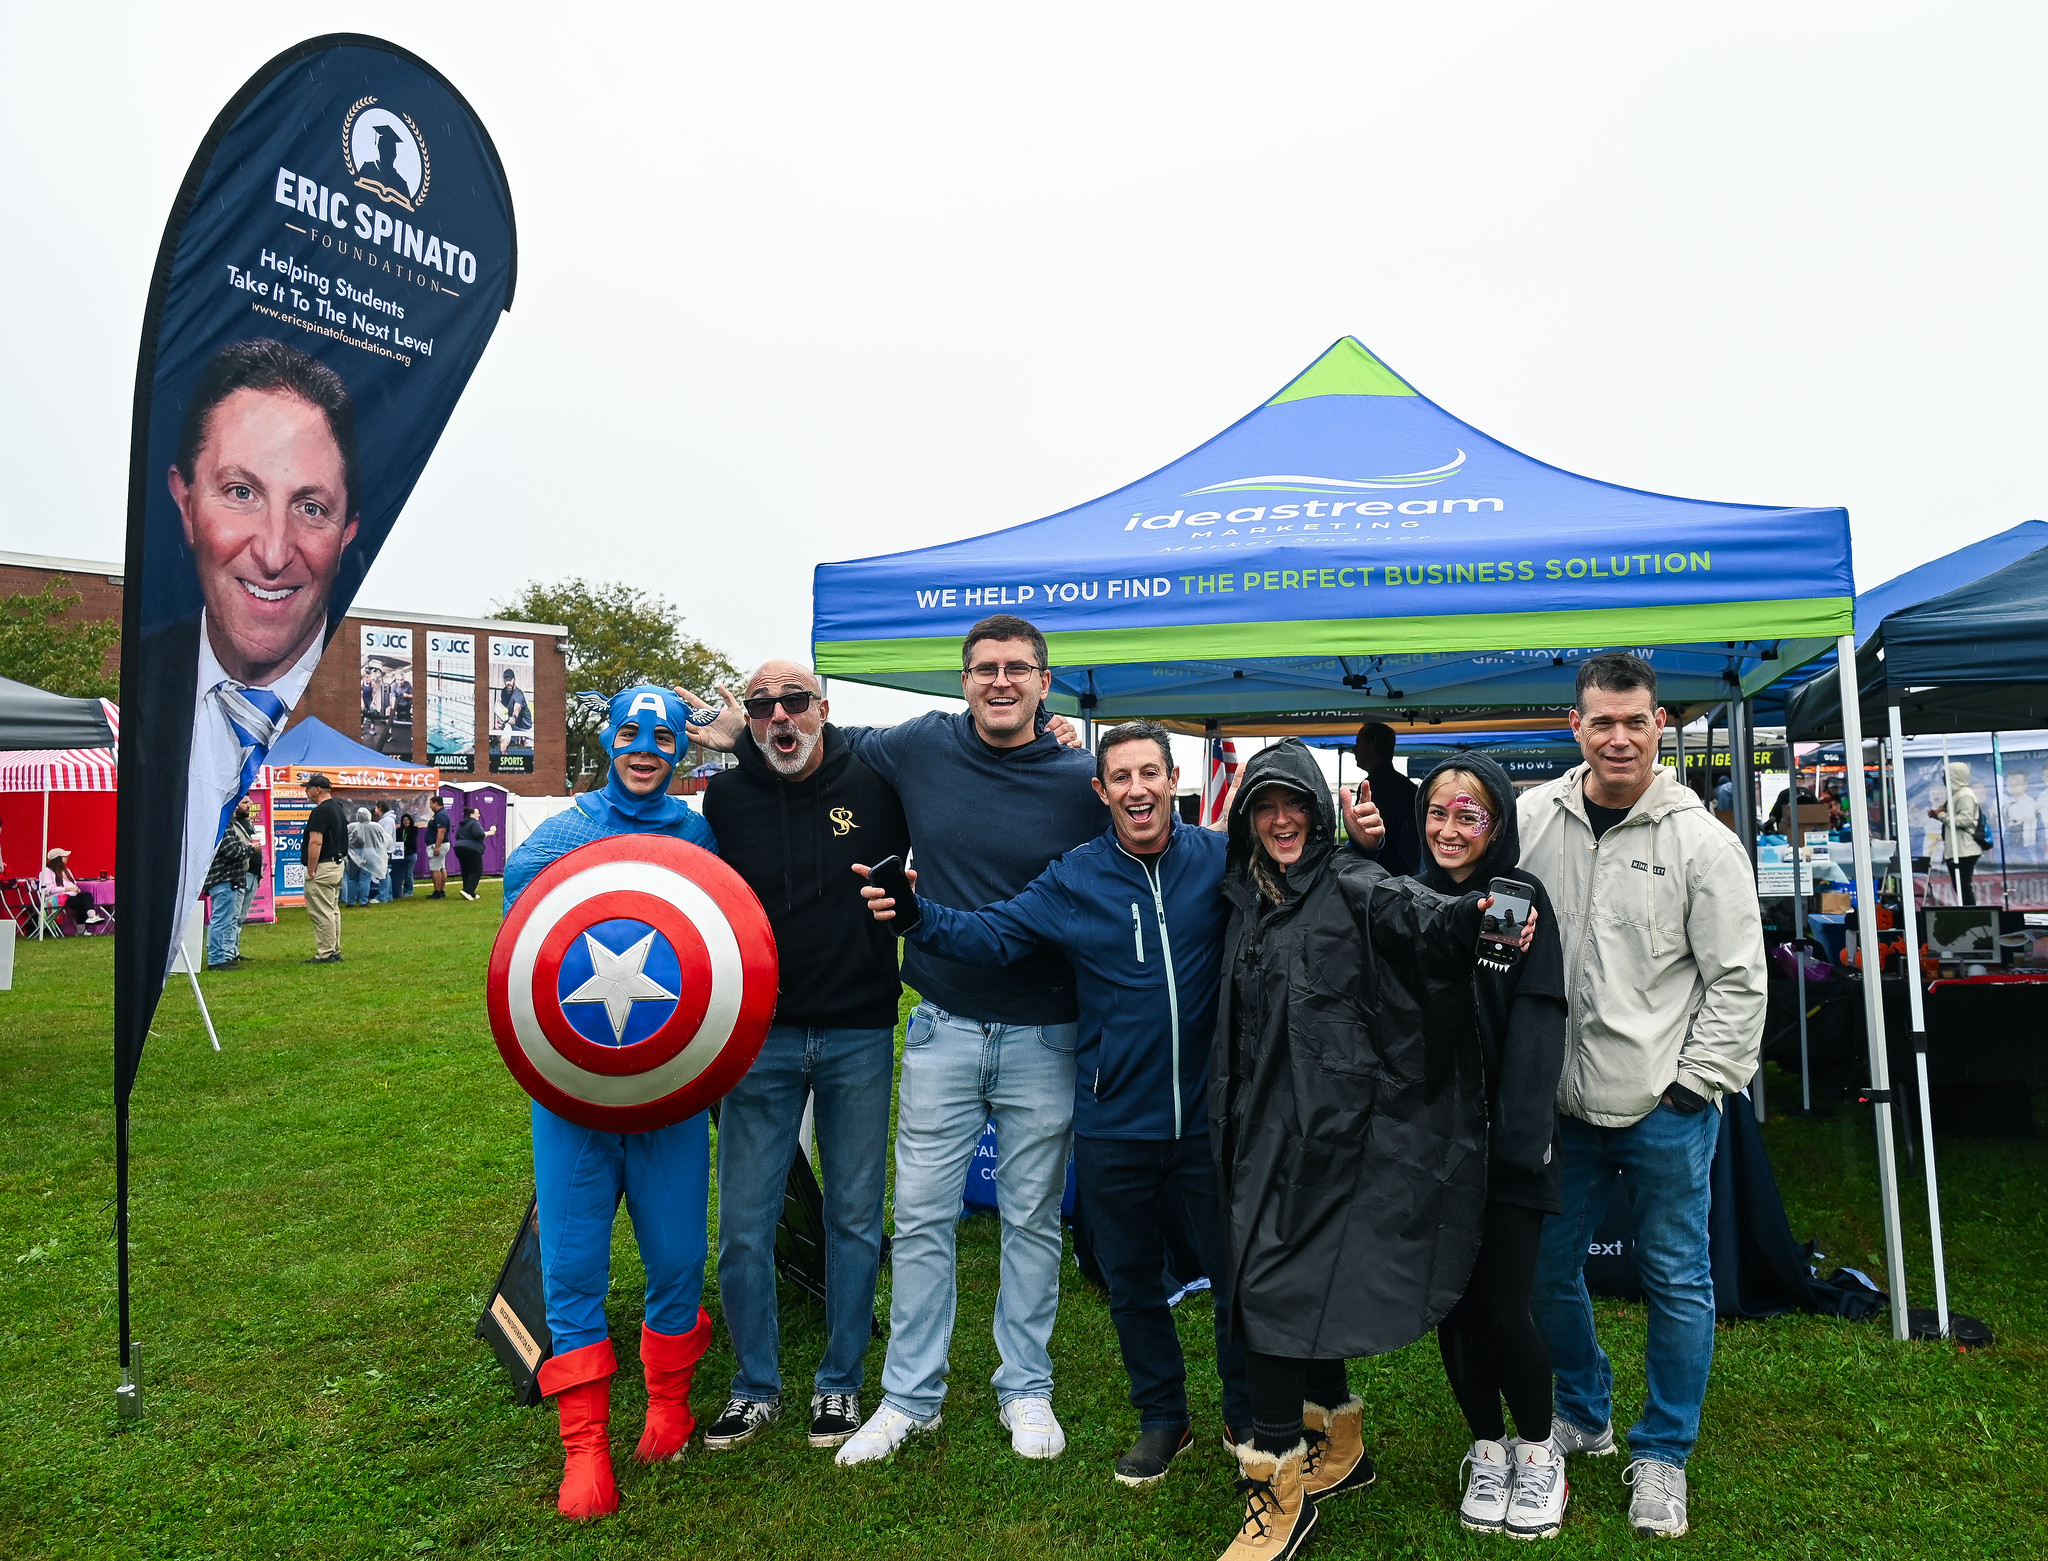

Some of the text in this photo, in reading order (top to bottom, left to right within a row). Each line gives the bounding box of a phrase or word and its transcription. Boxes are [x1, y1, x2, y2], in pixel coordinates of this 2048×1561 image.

[275, 166, 477, 284] ERIC SPINATO
[310, 228, 442, 293] FOUNDATION
[260, 248, 405, 319] Helping Students
[226, 264, 434, 357] Take It To The Next Level
[252, 302, 412, 367] www.ericspinatofoundation.org
[1124, 498, 1504, 532] ideastream
[1190, 521, 1420, 539] MARKETING
[915, 550, 1712, 609] WE HELP YOU FIND THE PERFECT BUSINESS SOLUTION
[366, 633, 407, 648] SYJCC
[431, 638, 470, 654] SYJCC
[494, 644, 529, 658] SYJCC
[628, 692, 667, 720] A
[434, 756, 468, 765] AQUATICS
[500, 756, 524, 766] SPORTS
[1510, 761, 1554, 771] SHOWS
[338, 770, 390, 786] Suffolk
[392, 772, 402, 786] Y
[406, 773, 436, 788] JCC
[1588, 1240, 1623, 1256] ext
